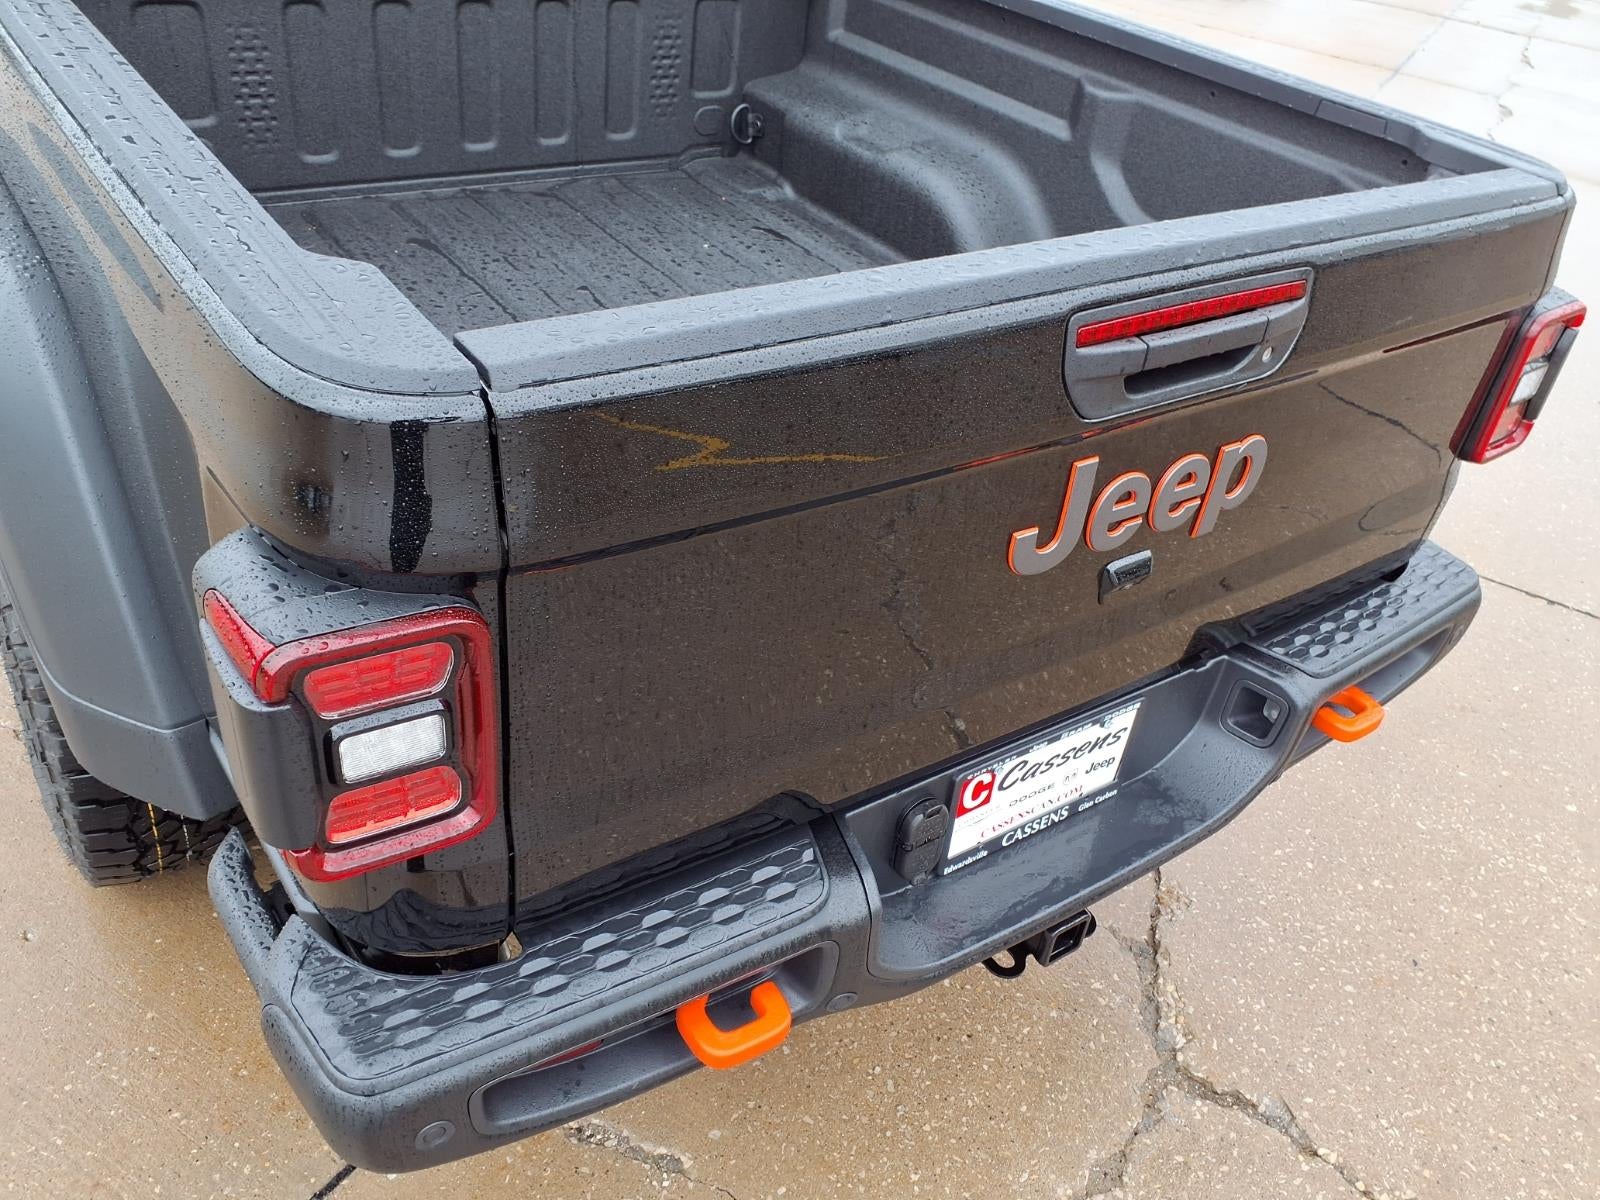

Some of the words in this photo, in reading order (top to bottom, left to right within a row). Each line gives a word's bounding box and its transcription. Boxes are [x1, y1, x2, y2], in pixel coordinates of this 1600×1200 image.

[1007, 434, 1268, 576] Jeep
[999, 727, 1128, 790] Cassens
[1085, 756, 1116, 775] Jeep
[944, 850, 988, 876] Edwardsville
[1002, 806, 1069, 847] CASSENS
[1078, 800, 1094, 812] Glen
[1095, 789, 1118, 804] Carbon
